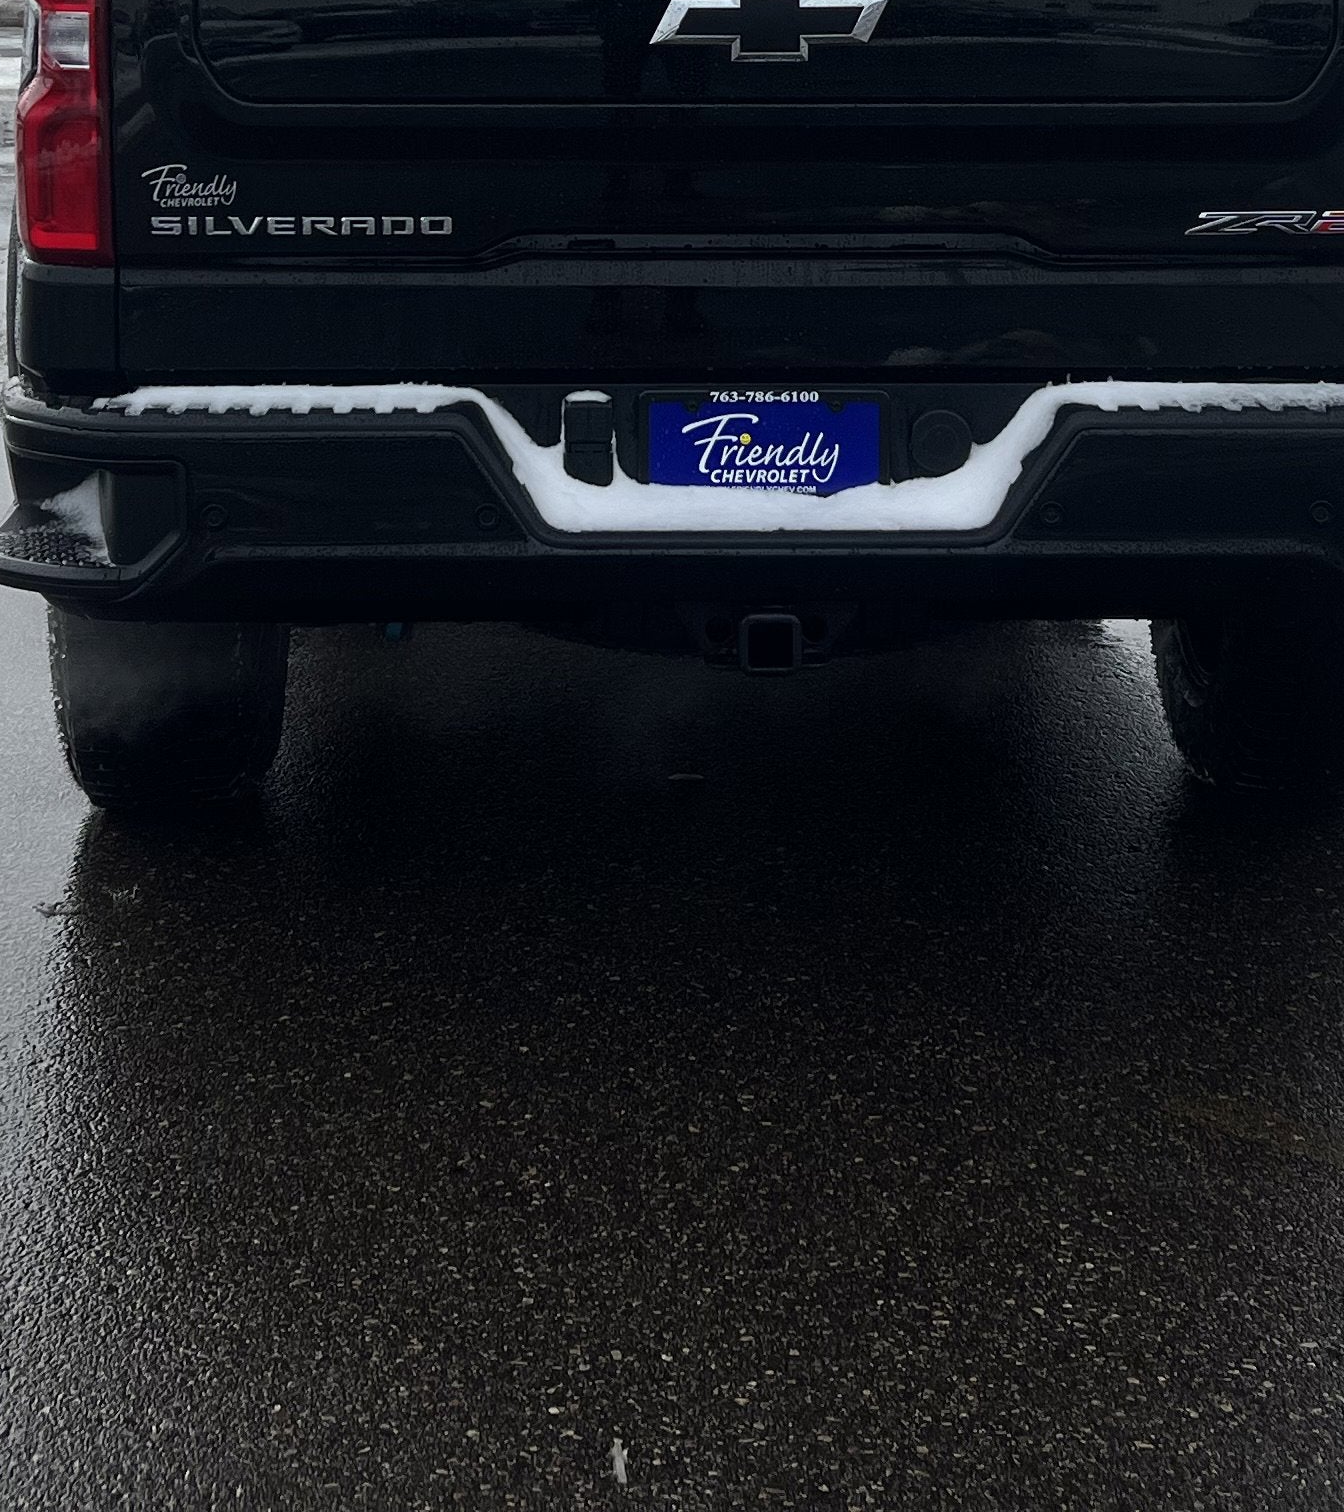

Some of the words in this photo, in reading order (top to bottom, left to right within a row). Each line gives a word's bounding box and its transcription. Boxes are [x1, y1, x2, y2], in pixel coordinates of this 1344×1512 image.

[141, 163, 237, 206] Friendly
[159, 196, 220, 208] CHEVROLET
[150, 215, 453, 236] SILVERADO
[709, 390, 820, 404] 763-786-6100
[682, 413, 839, 483] Friendly
[710, 468, 811, 484] CHEVROLET
